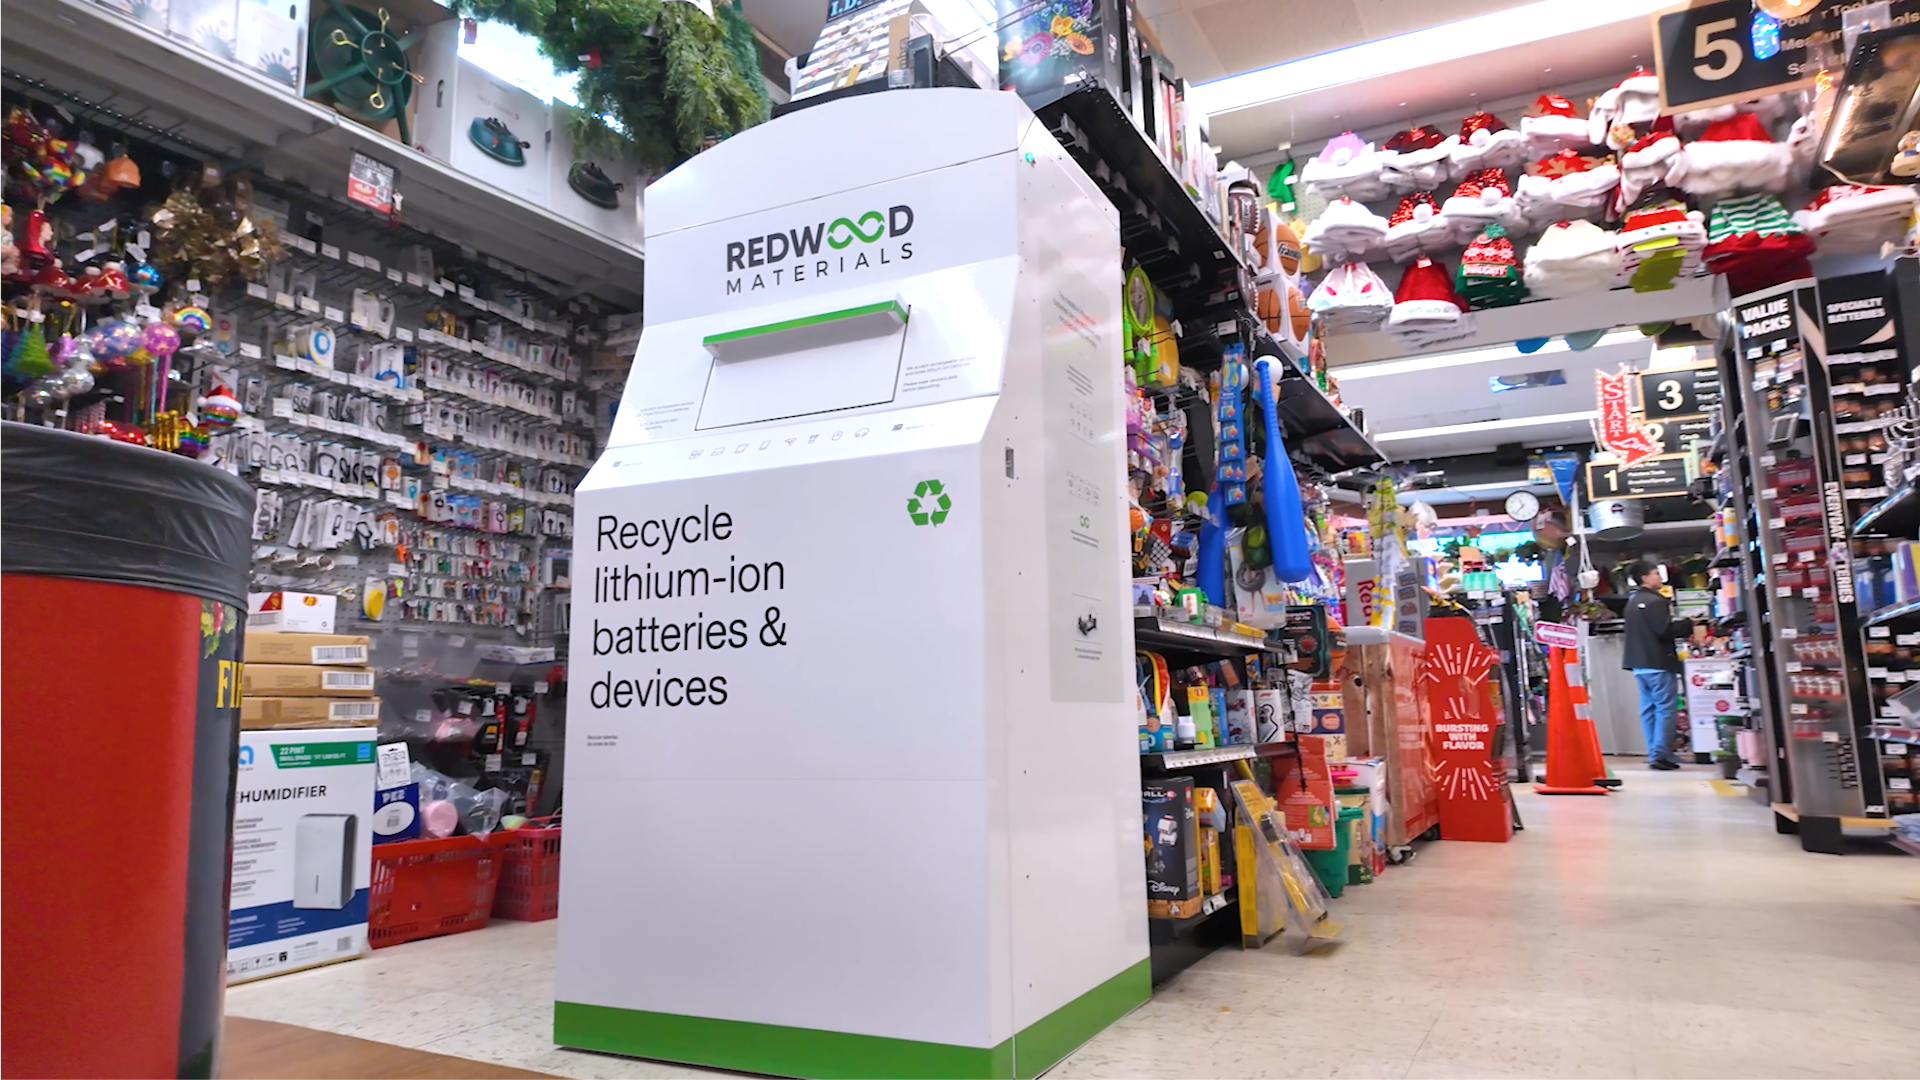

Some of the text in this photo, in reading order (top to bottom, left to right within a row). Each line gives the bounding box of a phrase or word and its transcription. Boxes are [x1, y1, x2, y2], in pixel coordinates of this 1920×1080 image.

[1692, 17, 1744, 82] 5
[726, 204, 915, 272] REDWOOD
[726, 242, 913, 296] MATERIALS
[1741, 297, 1789, 323] VALUE
[1825, 296, 1883, 314] SPECIALTY
[1827, 307, 1887, 325] BATTERIES
[1743, 314, 1792, 340] PACKS
[1602, 381, 1625, 437] START
[1657, 379, 1684, 411] 3
[1603, 469, 1618, 492] 1
[597, 504, 733, 556] Recycle
[1823, 481, 1856, 604] EVERYDAY BTERIES
[595, 555, 785, 604] lithium-ion
[593, 606, 787, 656] batteries &
[590, 668, 729, 709] devices
[1435, 723, 1490, 733] BURSTING
[1448, 732, 1477, 741] WITH
[1443, 740, 1485, 750] FLAVOR
[382, 789, 405, 804] PEZ
[1142, 789, 1177, 799] ALL-E
